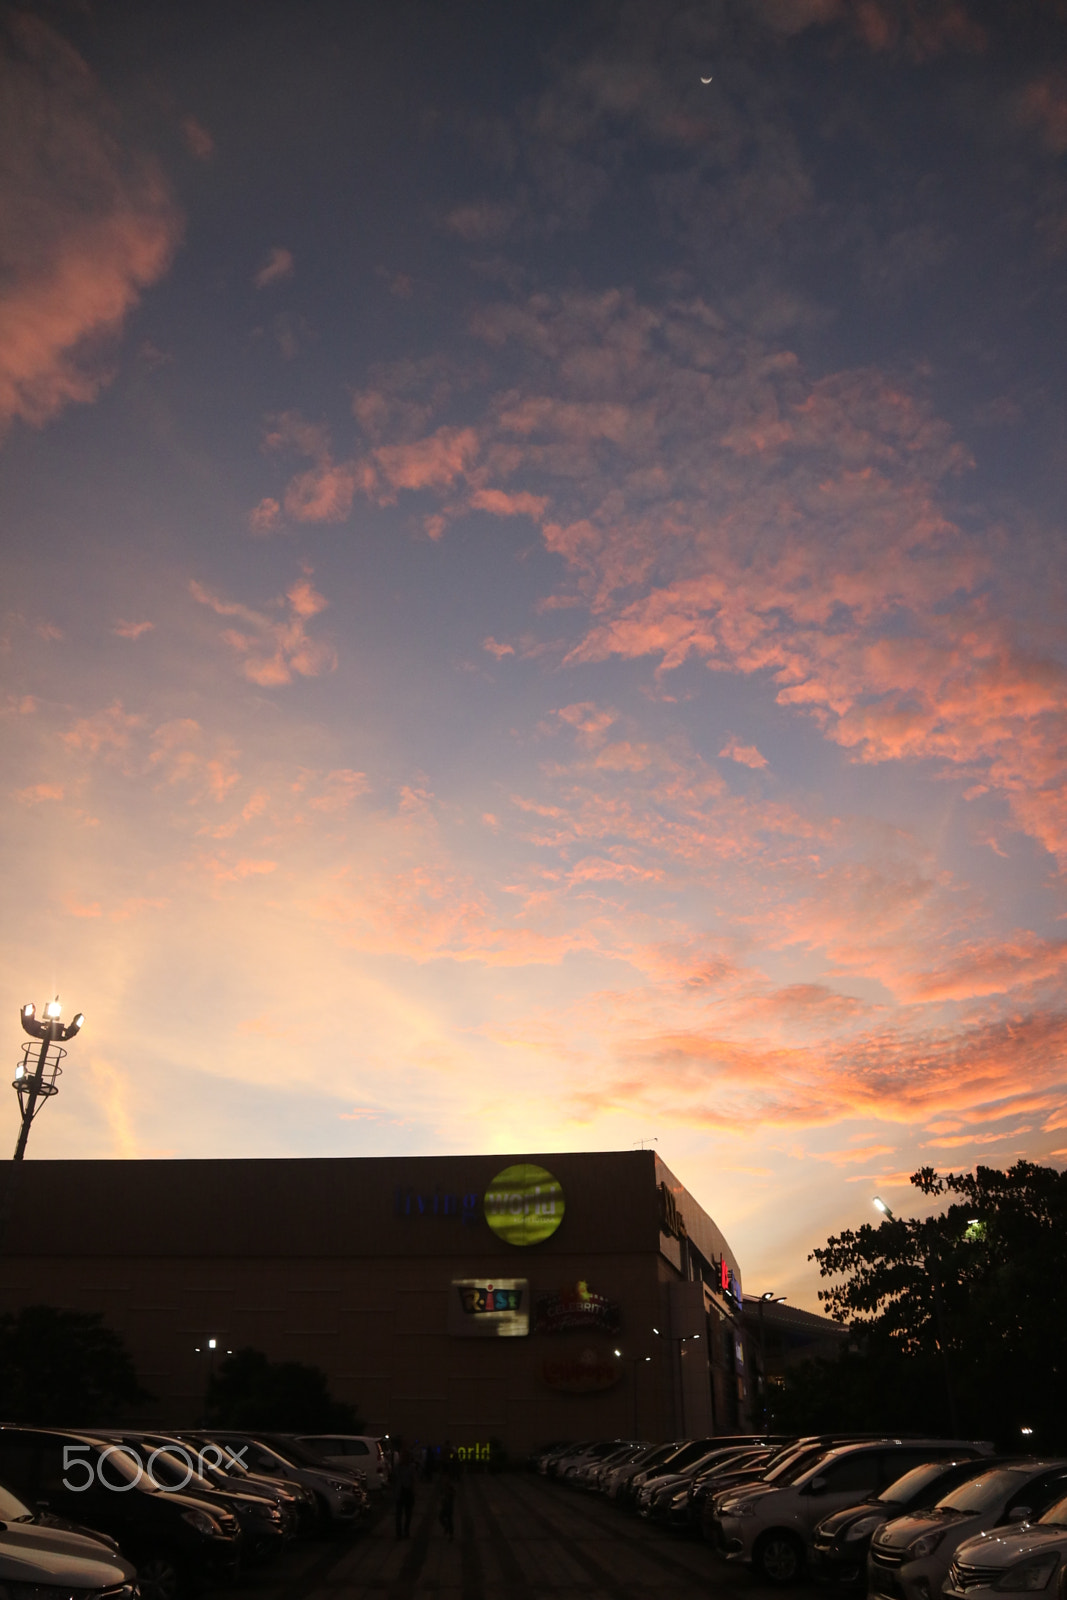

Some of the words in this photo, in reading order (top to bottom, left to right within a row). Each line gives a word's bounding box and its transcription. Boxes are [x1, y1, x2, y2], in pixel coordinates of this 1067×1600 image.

[395, 1185, 478, 1227] living
[489, 1187, 554, 1215] world
[547, 1302, 608, 1317] CELEBRITY
[450, 1442, 490, 1461] orld
